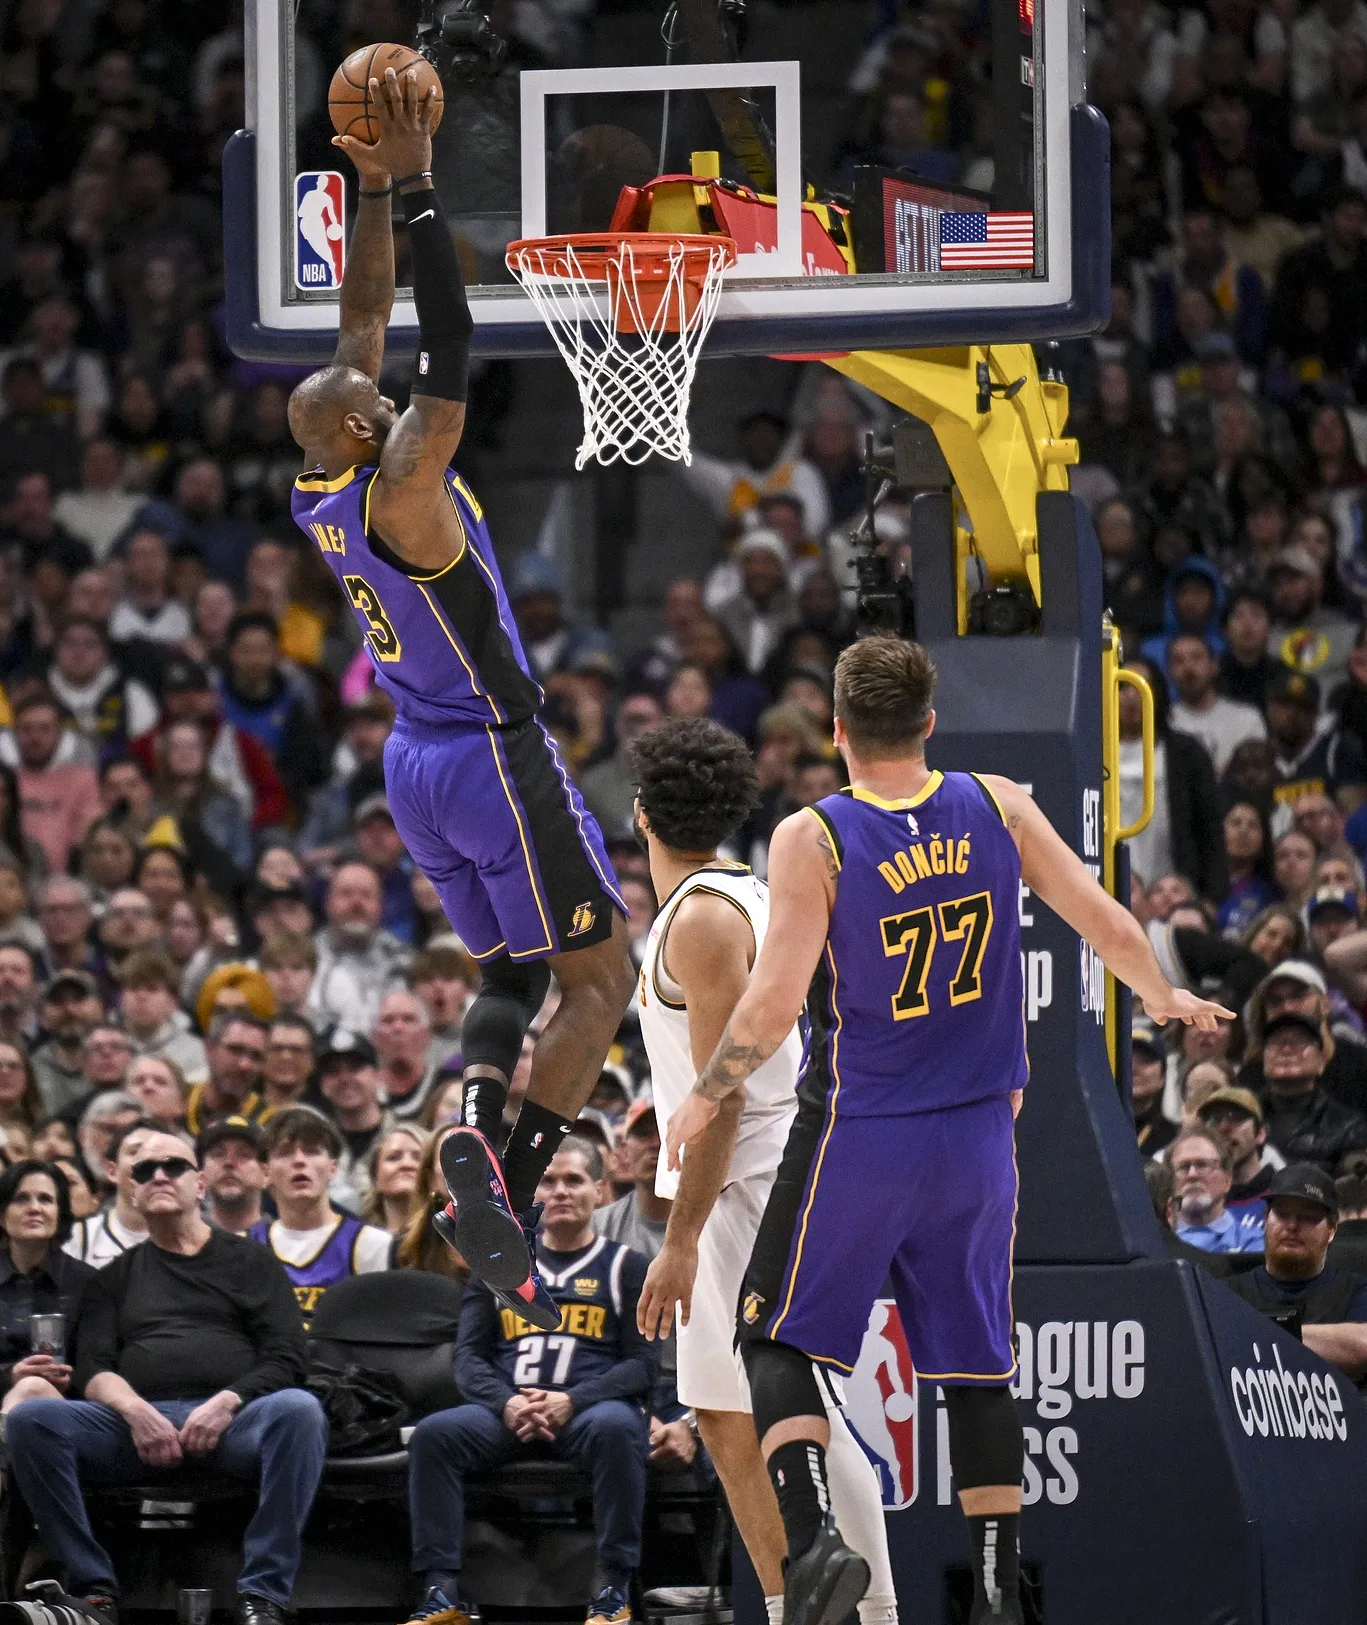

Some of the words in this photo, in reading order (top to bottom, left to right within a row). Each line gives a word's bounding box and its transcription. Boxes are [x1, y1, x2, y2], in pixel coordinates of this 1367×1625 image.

[302, 263, 327, 283] NBA
[876, 832, 972, 895] DONČIĆ
[879, 890, 995, 1022] 77
[514, 1335, 577, 1386] 27
[1230, 1341, 1347, 1442] coinbase
